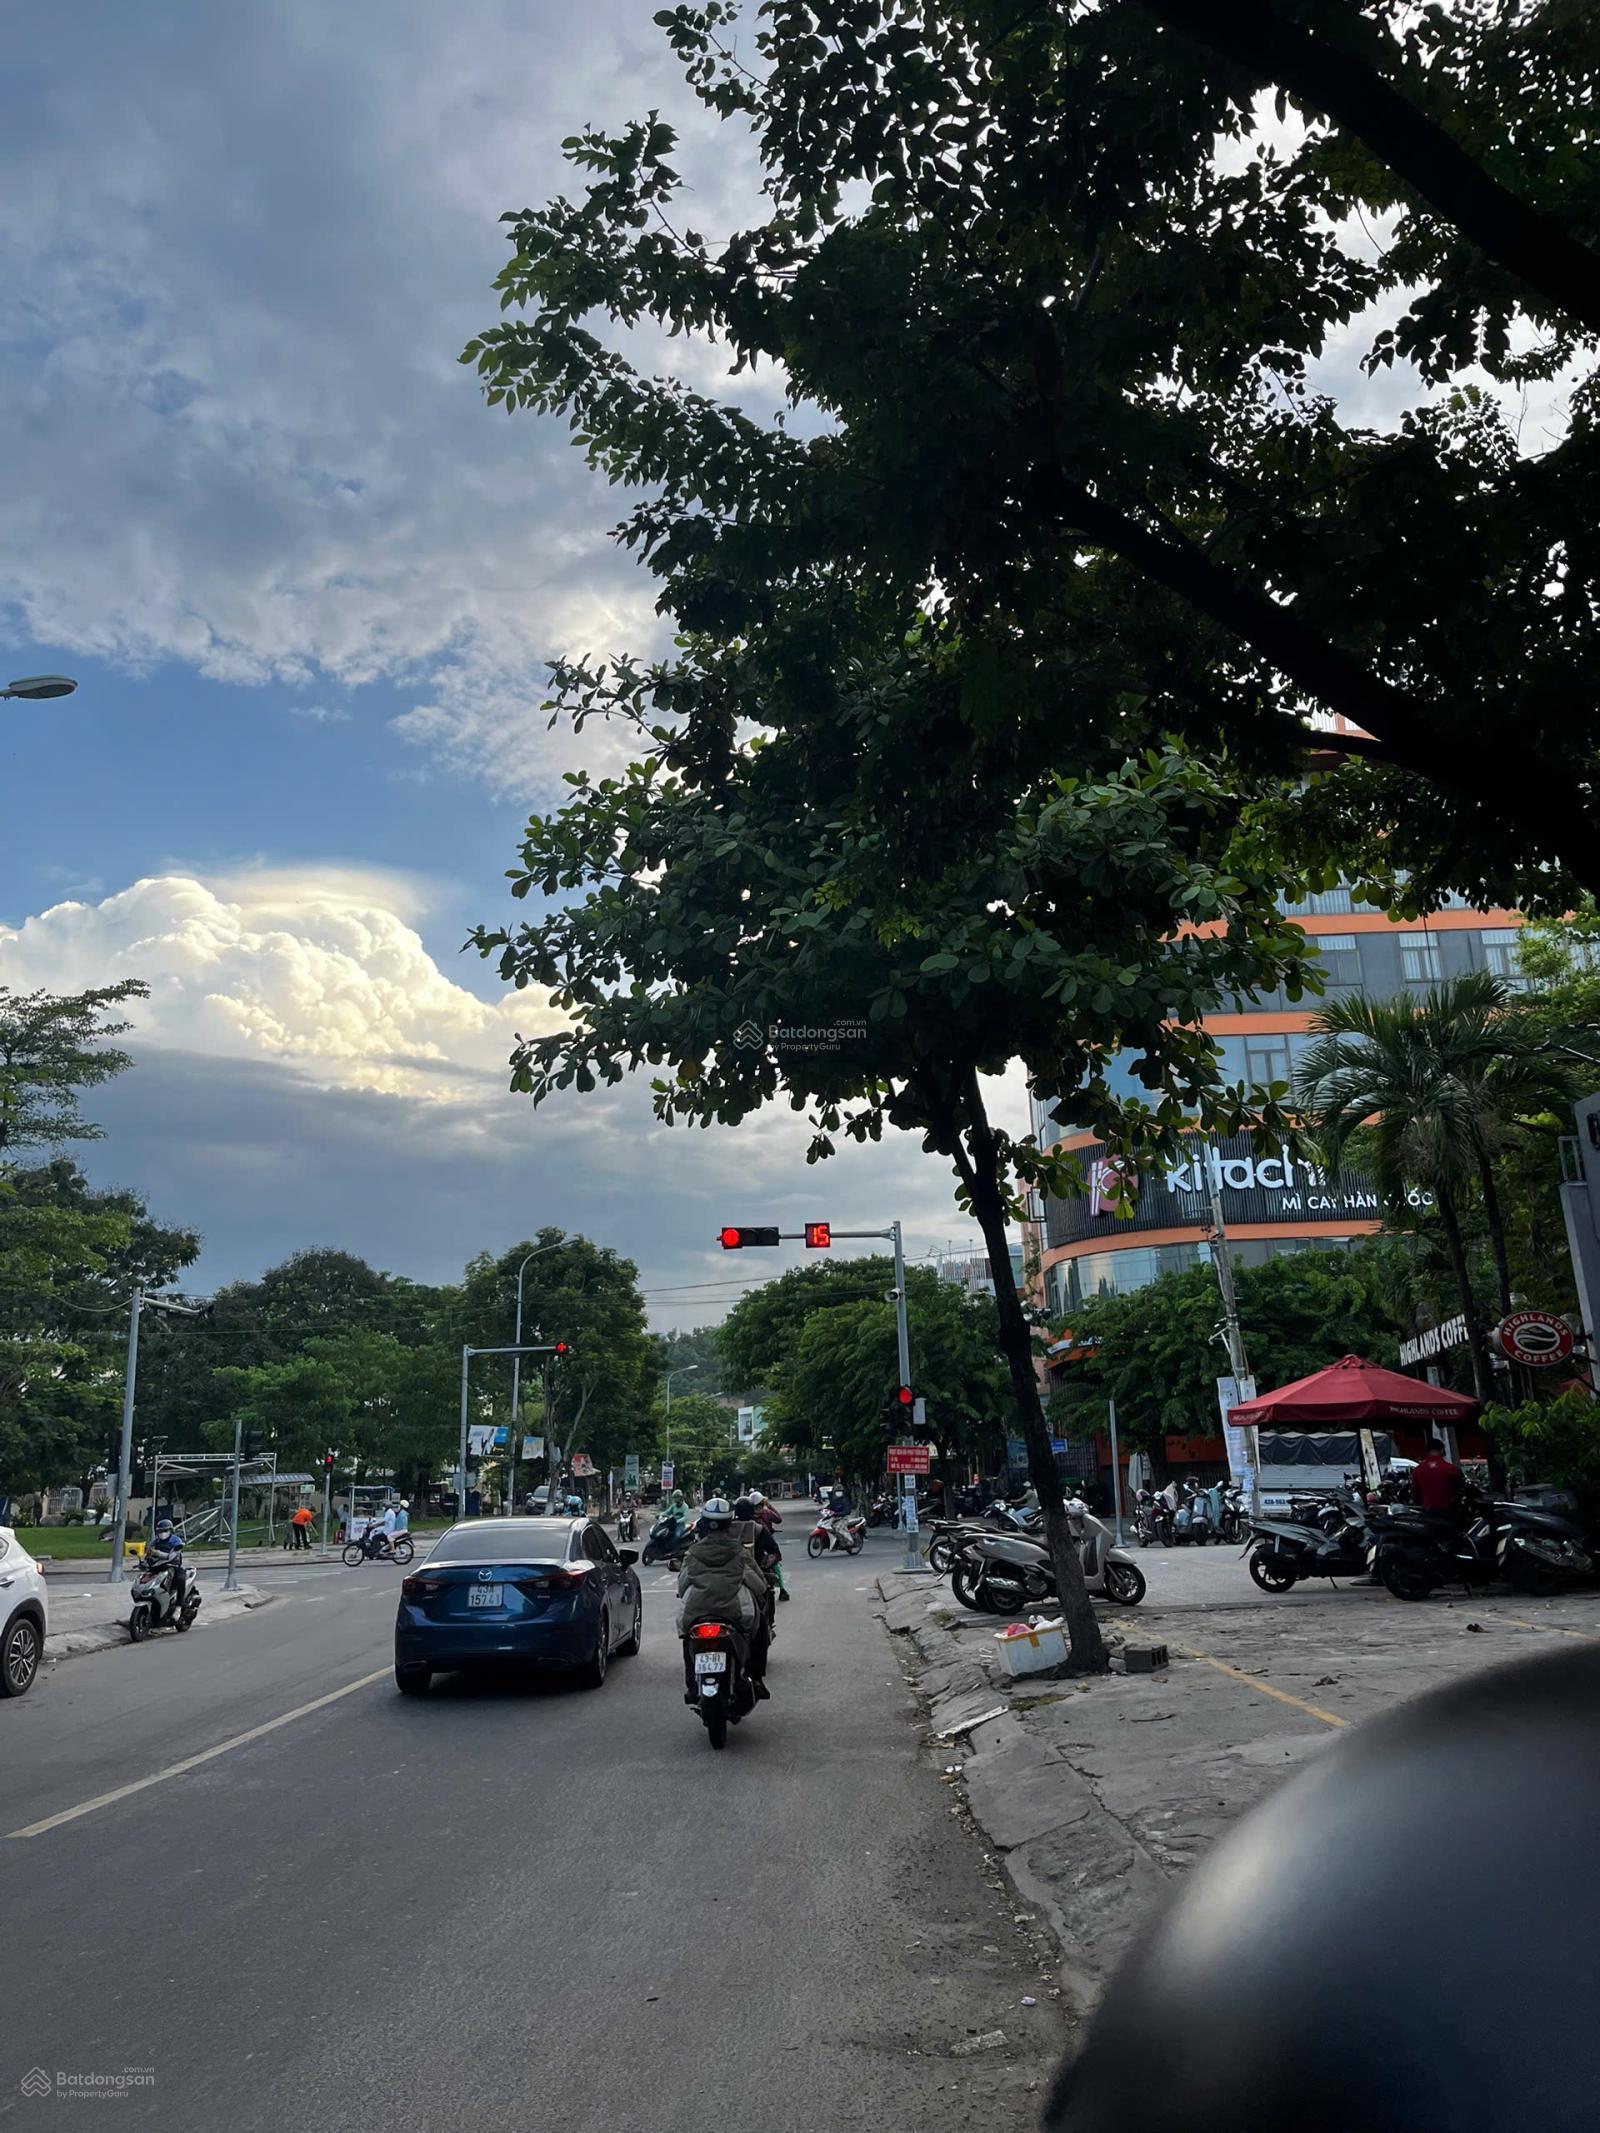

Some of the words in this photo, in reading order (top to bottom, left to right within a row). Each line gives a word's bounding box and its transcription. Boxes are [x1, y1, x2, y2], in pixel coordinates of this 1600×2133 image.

[1282, 1192, 1302, 1210] MÌ
[1343, 1191, 1378, 1208] HÀN
[1383, 1187, 1434, 1207] ỐC
[813, 1225, 829, 1246] 15
[1503, 1311, 1568, 1336] HIGHLANDS
[1399, 1327, 1441, 1367] HIGHLANDS
[1441, 1314, 1470, 1349] COFF
[1514, 1349, 1565, 1363] COFFEE
